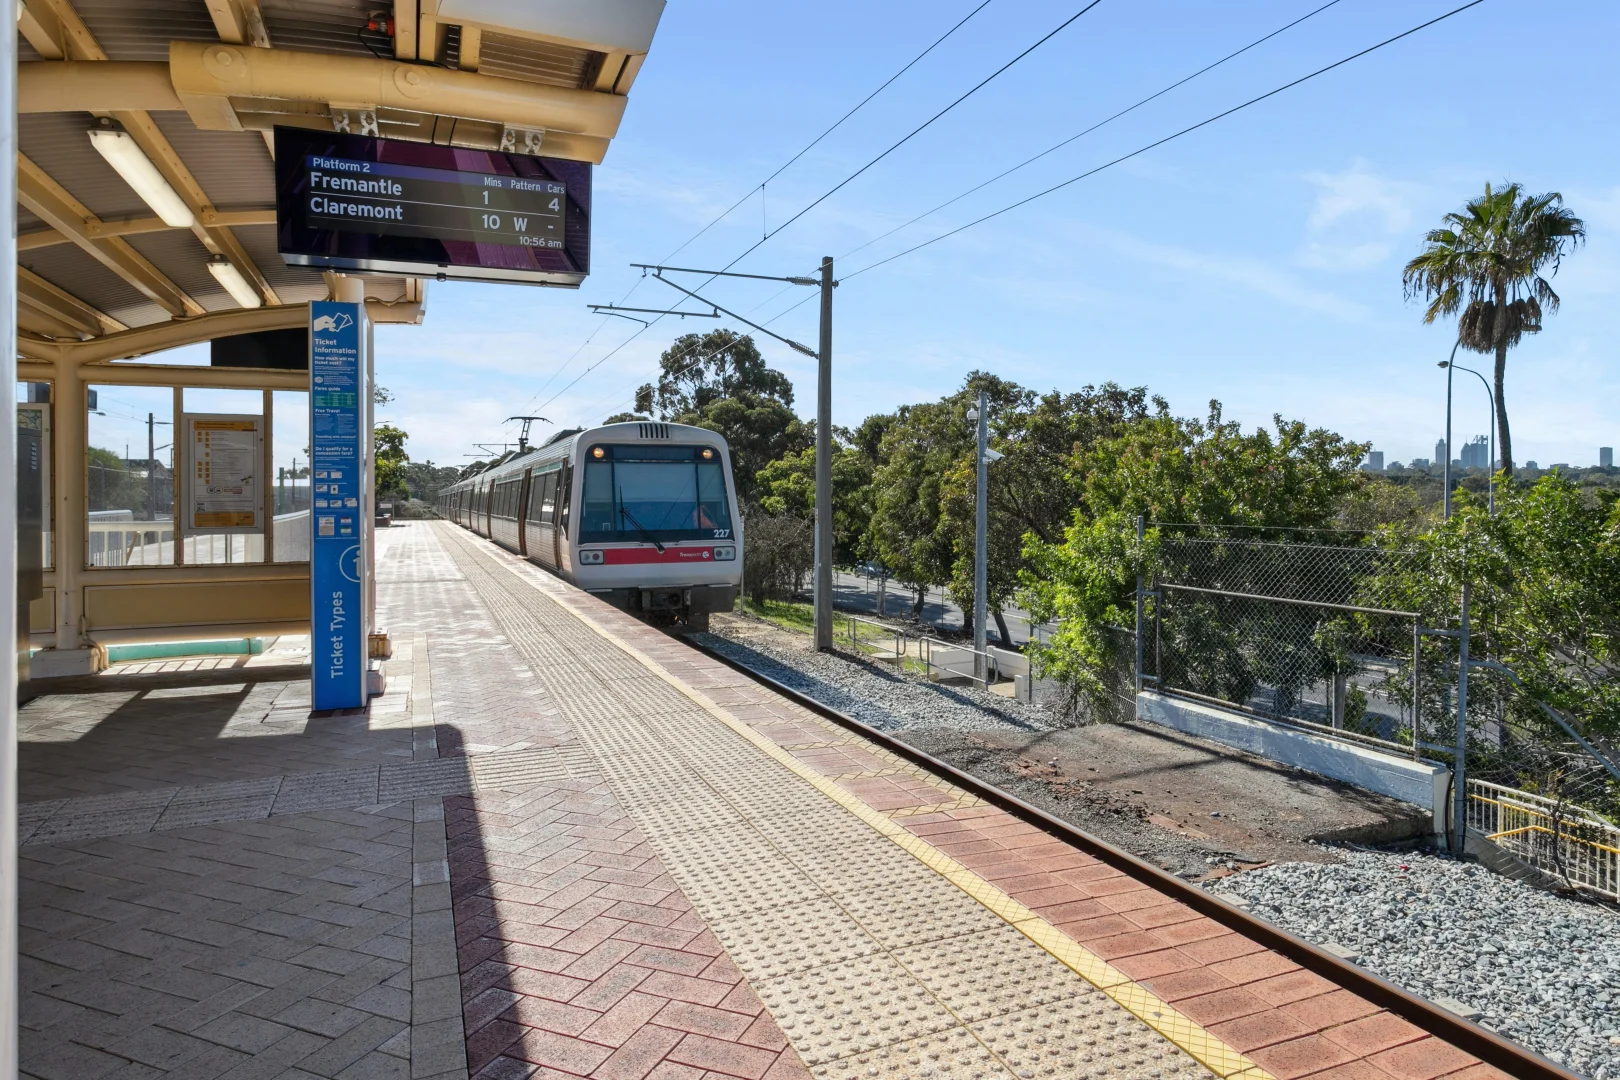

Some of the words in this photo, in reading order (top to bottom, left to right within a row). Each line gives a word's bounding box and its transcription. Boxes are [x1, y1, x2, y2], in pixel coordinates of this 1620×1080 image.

[312, 157, 360, 172] Platform
[362, 162, 370, 172] 2
[310, 172, 402, 196] Fremantle
[482, 191, 489, 205] 1
[548, 198, 560, 212] 4
[484, 177, 502, 188] Mins
[510, 180, 540, 192] Pattern
[547, 183, 564, 194] Cars
[310, 197, 403, 220] Claremont
[482, 214, 500, 230] 10
[513, 217, 528, 232] W
[519, 236, 546, 248] 10:56
[547, 239, 562, 248] am
[714, 529, 730, 538] 227
[330, 591, 346, 632] Types
[330, 636, 343, 679] Ticket
